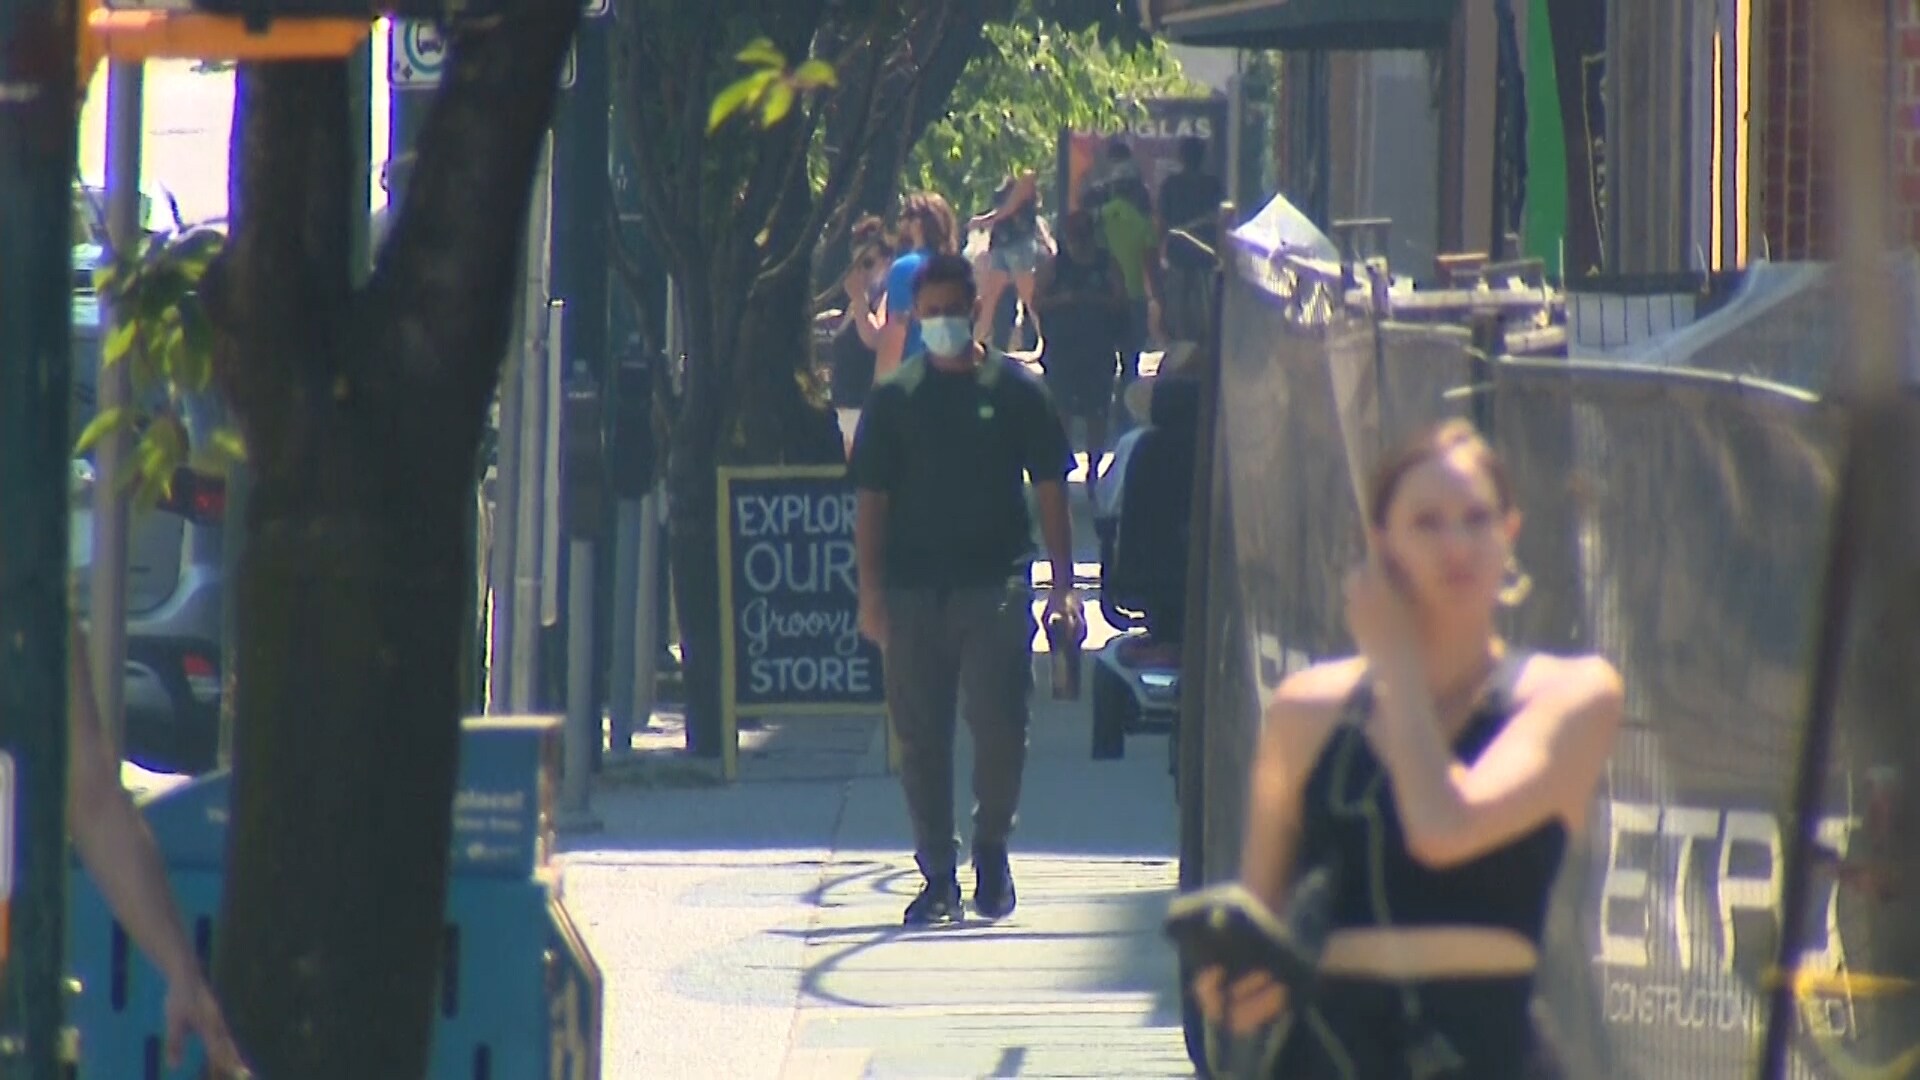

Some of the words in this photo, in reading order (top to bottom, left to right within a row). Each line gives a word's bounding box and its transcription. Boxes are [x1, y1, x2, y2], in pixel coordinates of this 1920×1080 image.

[737, 494, 858, 536] EXPLOR
[744, 541, 858, 593] OUR
[751, 657, 871, 693] STORE
